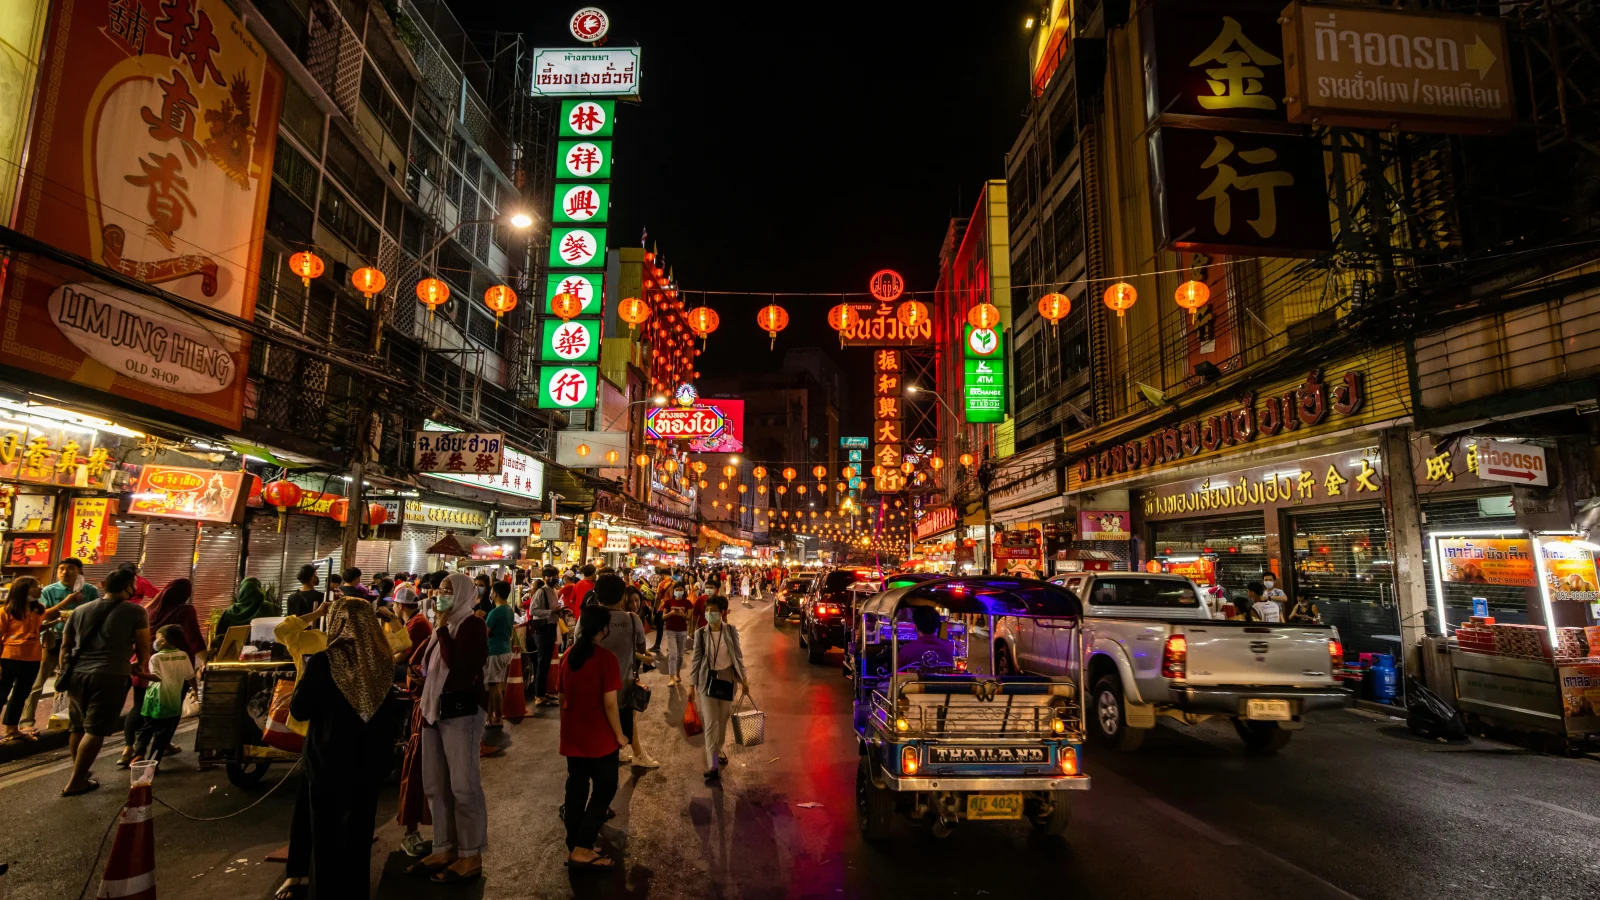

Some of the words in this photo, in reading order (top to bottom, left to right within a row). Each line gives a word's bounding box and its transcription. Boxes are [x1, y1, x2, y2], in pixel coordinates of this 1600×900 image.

[1314, 12, 1460, 72] ที่จอดรถ
[1188, 15, 1295, 239] 金行
[59, 288, 112, 339] LIM
[111, 310, 168, 364] JING
[171, 332, 230, 386] HIENG
[125, 358, 148, 375] OLD
[152, 367, 179, 385] SHOP
[976, 375, 993, 384] ATM
[655, 411, 716, 434] ทองใบ
[1480, 443, 1543, 471] ที่จอดรถ
[75, 518, 96, 557] 林真香
[936, 747, 1044, 761] THAILAND
